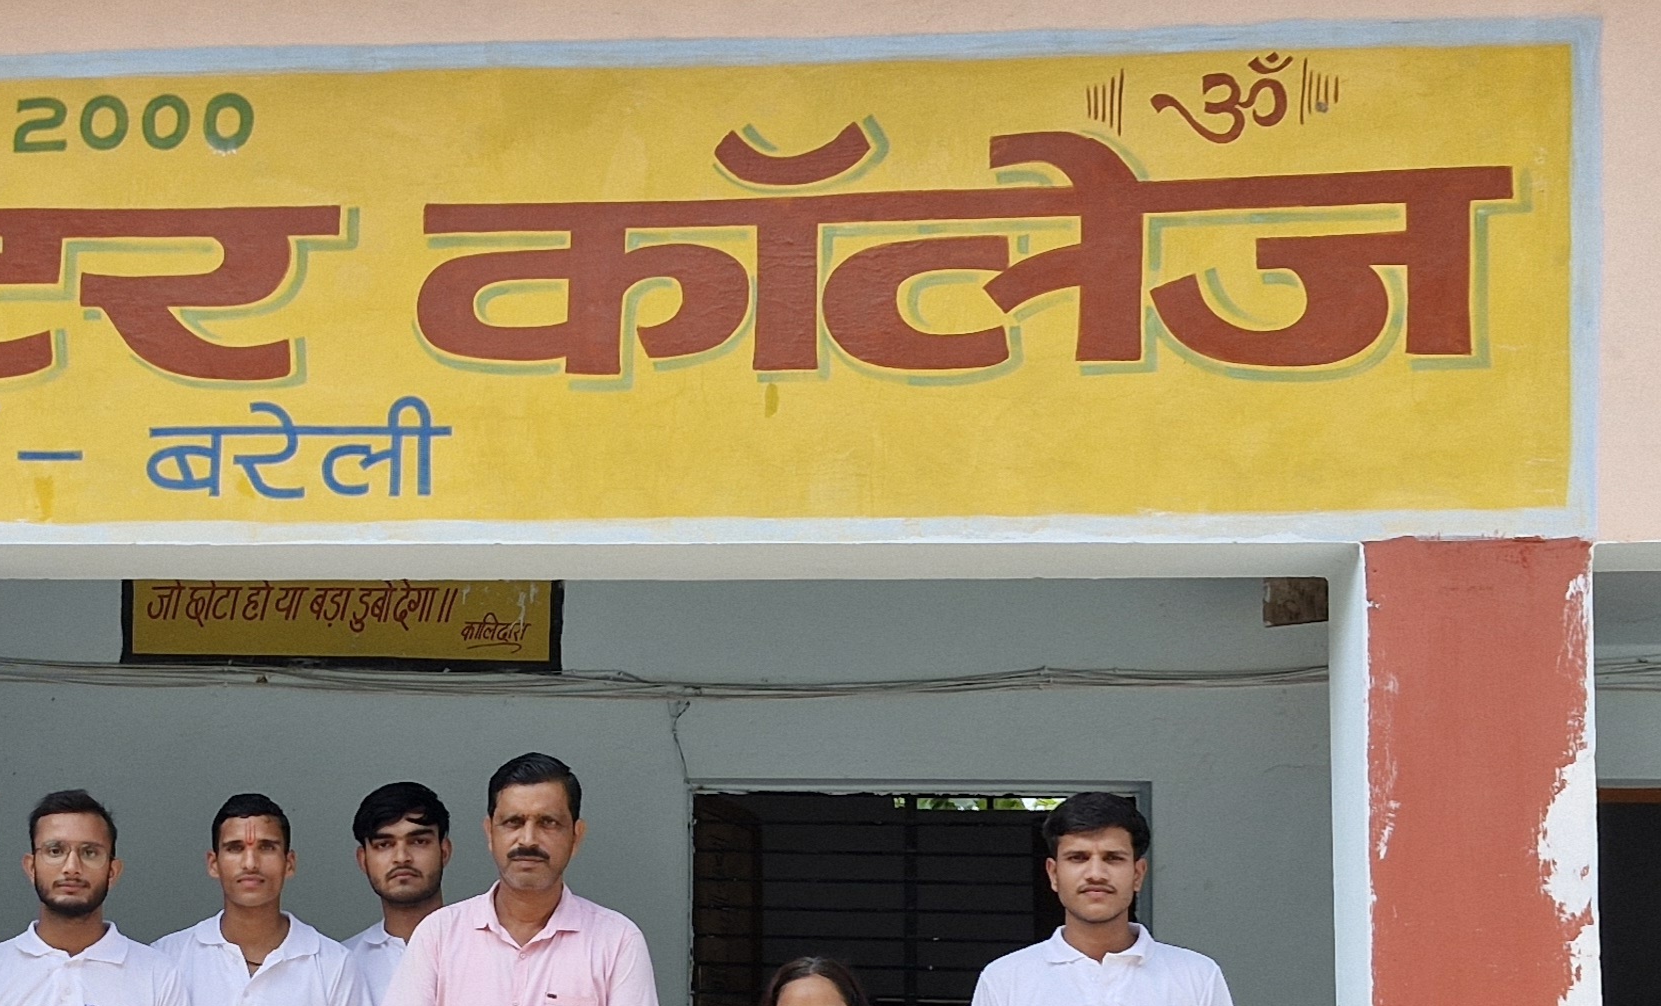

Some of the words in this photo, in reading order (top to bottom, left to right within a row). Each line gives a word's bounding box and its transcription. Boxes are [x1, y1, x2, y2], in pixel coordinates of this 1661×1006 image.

[12, 92, 255, 153] 2000
[417, 121, 1514, 376] कॉलेज
[146, 396, 452, 499] बरेली
[147, 579, 186, 620] जो
[185, 580, 242, 628] छोटा
[241, 580, 274, 621] हो
[275, 587, 309, 621] या
